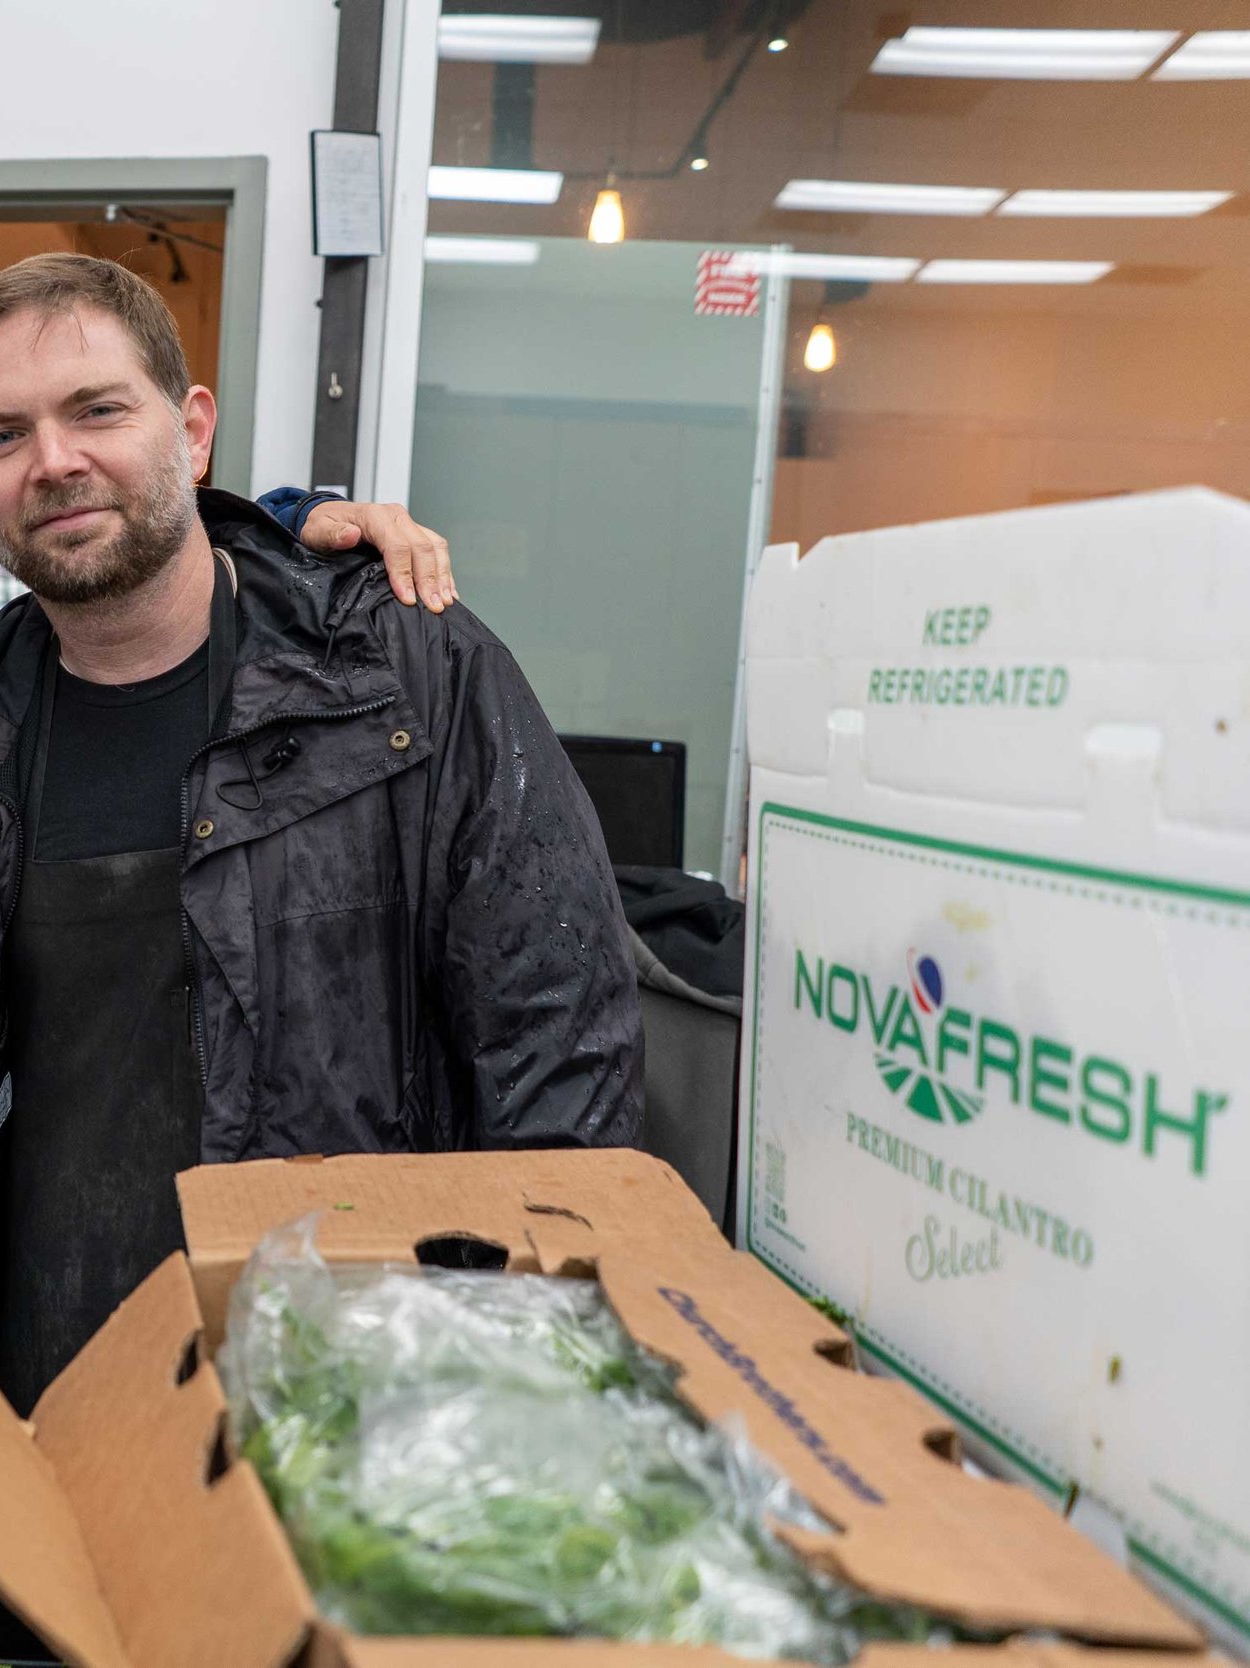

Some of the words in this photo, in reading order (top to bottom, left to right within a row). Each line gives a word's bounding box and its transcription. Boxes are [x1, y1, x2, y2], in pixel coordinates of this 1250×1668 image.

[922, 606, 990, 647] KEEP
[868, 666, 1070, 707] REFRIGERATED
[795, 948, 1209, 1178] NOVAFRESH
[847, 1111, 944, 1193] PREMIUM
[950, 1166, 1094, 1270] CILANTRO
[905, 1214, 1002, 1283] Select
